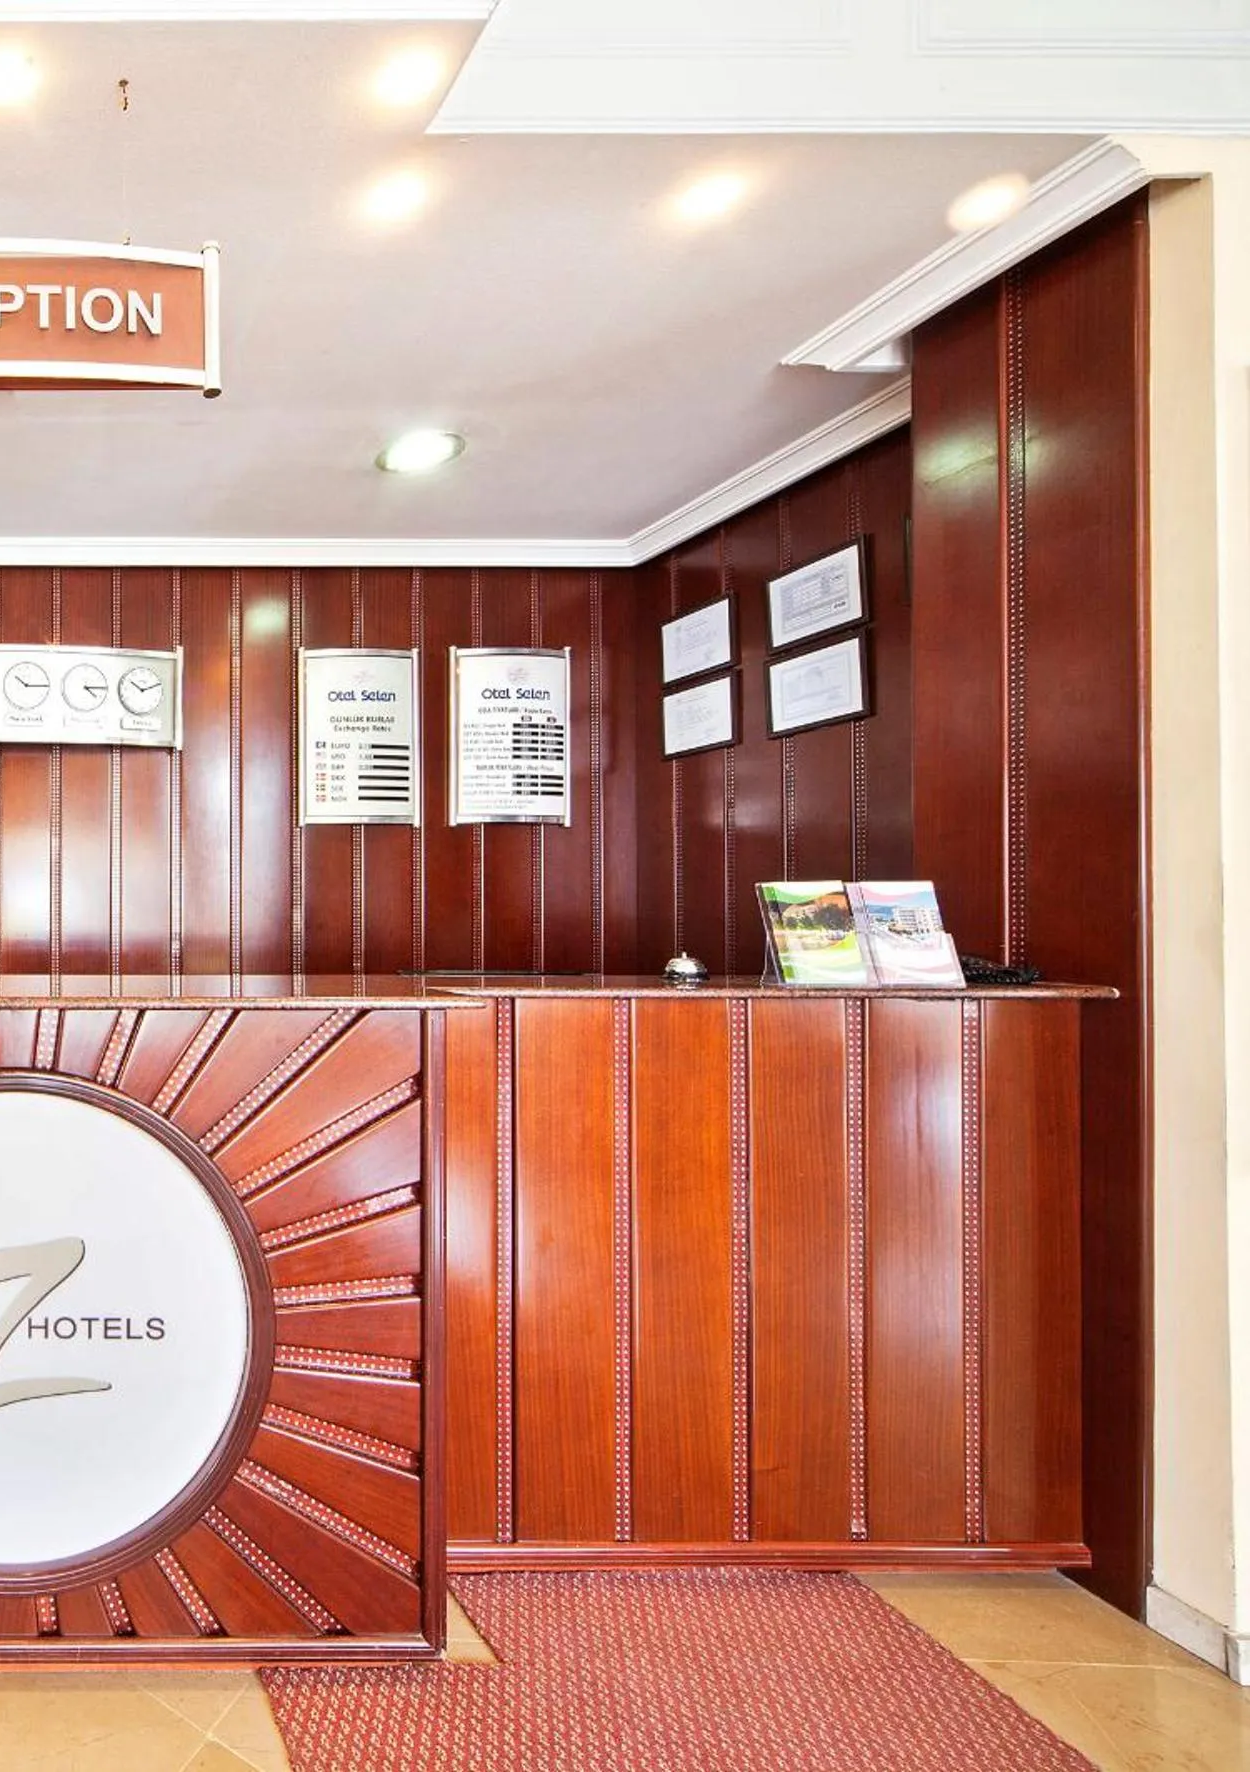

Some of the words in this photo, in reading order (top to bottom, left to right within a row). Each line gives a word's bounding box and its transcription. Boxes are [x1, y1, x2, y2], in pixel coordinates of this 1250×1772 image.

[328, 690, 356, 702] Otel
[361, 690, 396, 702] Selen
[481, 688, 511, 699] Otel
[516, 688, 550, 700] Selen
[27, 1316, 166, 1340] HOTELS
